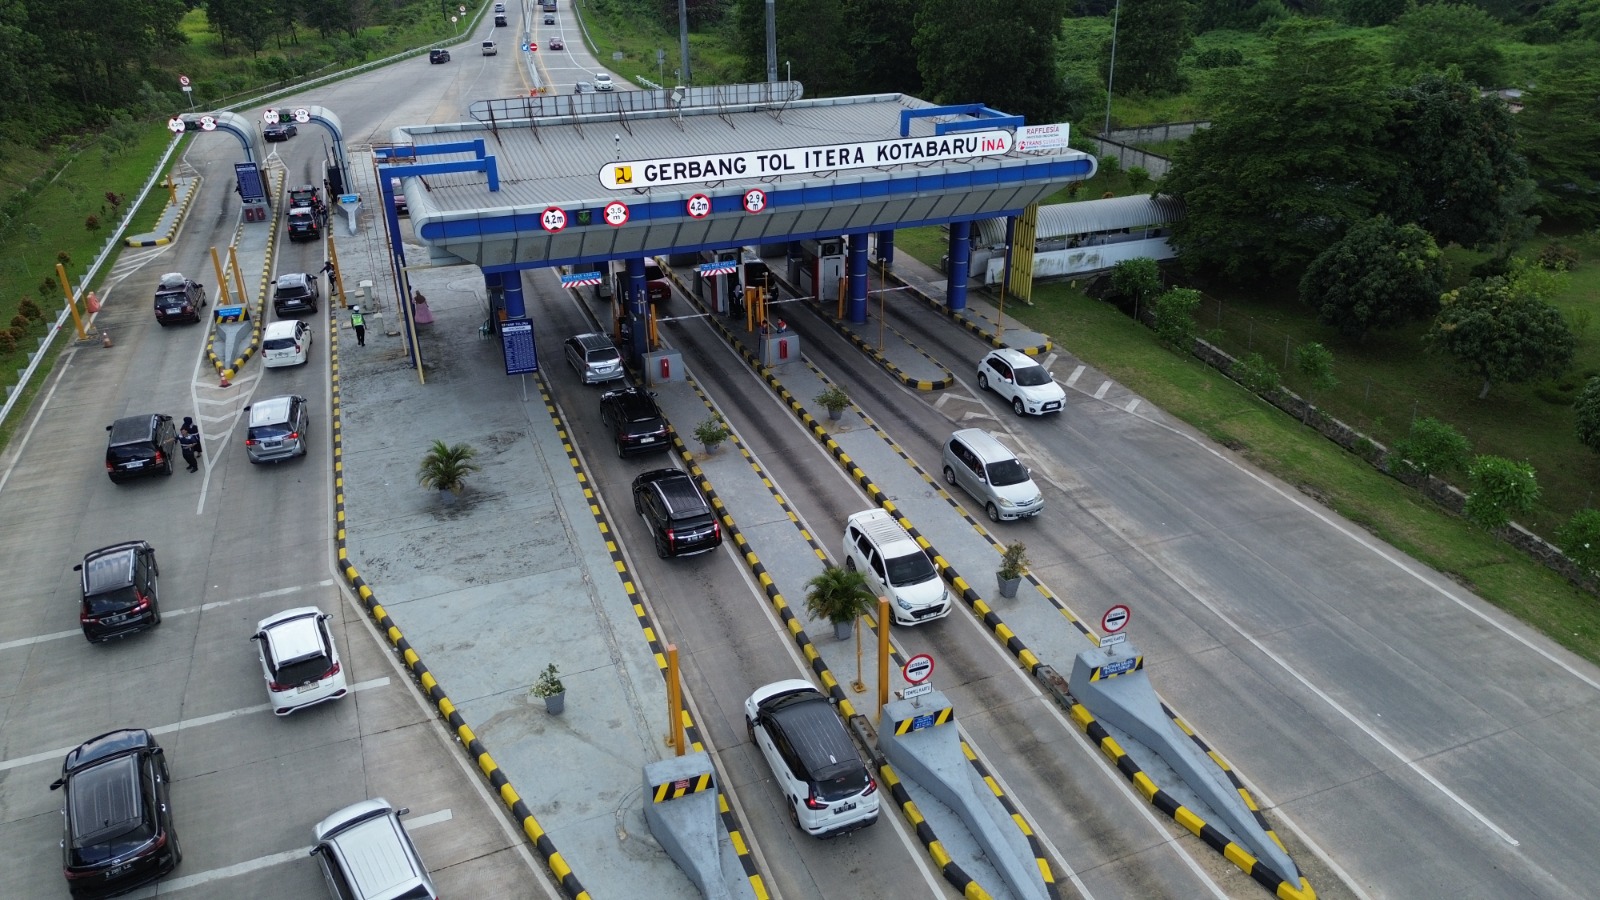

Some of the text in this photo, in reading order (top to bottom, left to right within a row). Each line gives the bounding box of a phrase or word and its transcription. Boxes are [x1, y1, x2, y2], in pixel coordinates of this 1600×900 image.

[644, 136, 978, 182] GERBANG TOL ITERA KOTABARU
